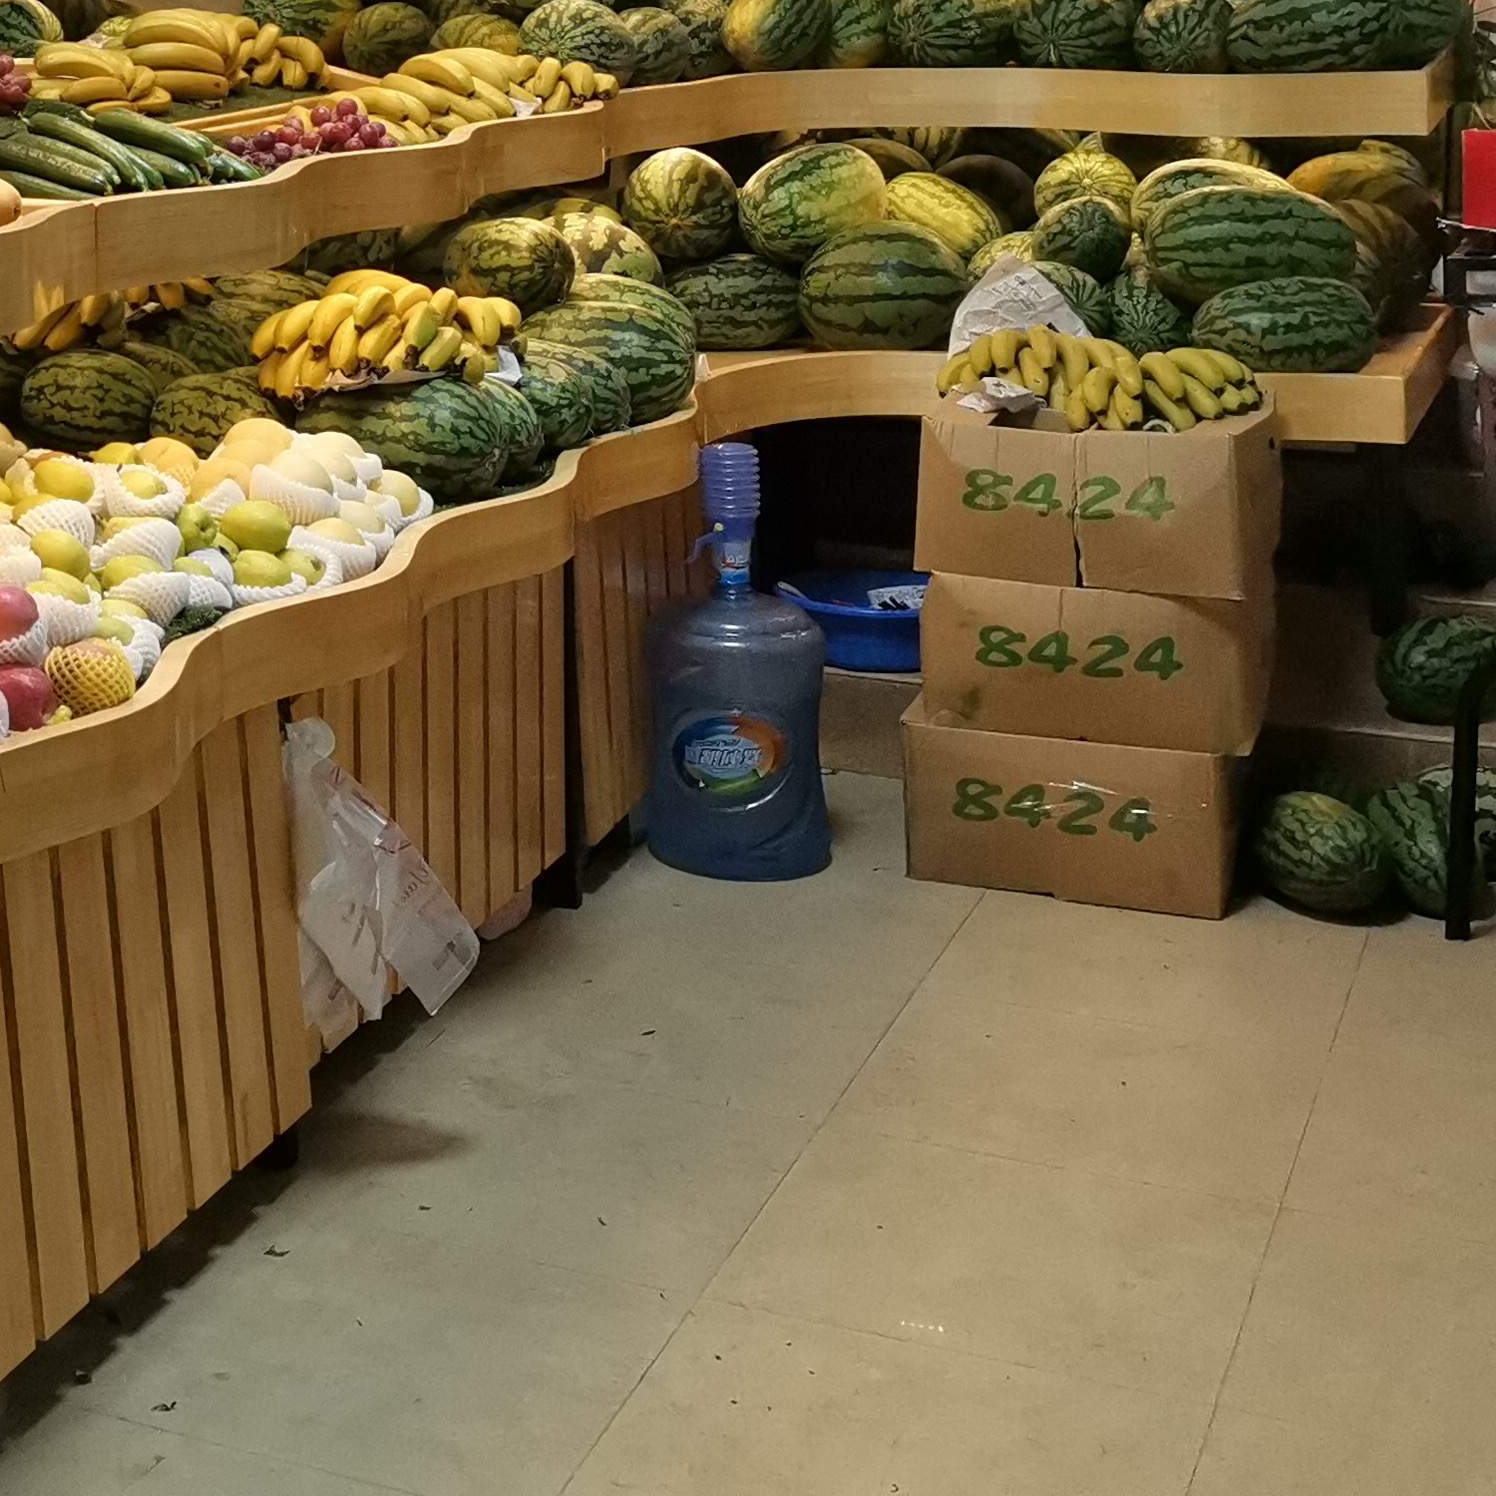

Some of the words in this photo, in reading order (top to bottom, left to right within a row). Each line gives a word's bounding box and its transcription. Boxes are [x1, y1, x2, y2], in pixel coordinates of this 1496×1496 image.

[961, 468, 1176, 521] 8424
[975, 625, 1184, 681] 8424
[951, 776, 1158, 843] 8424
